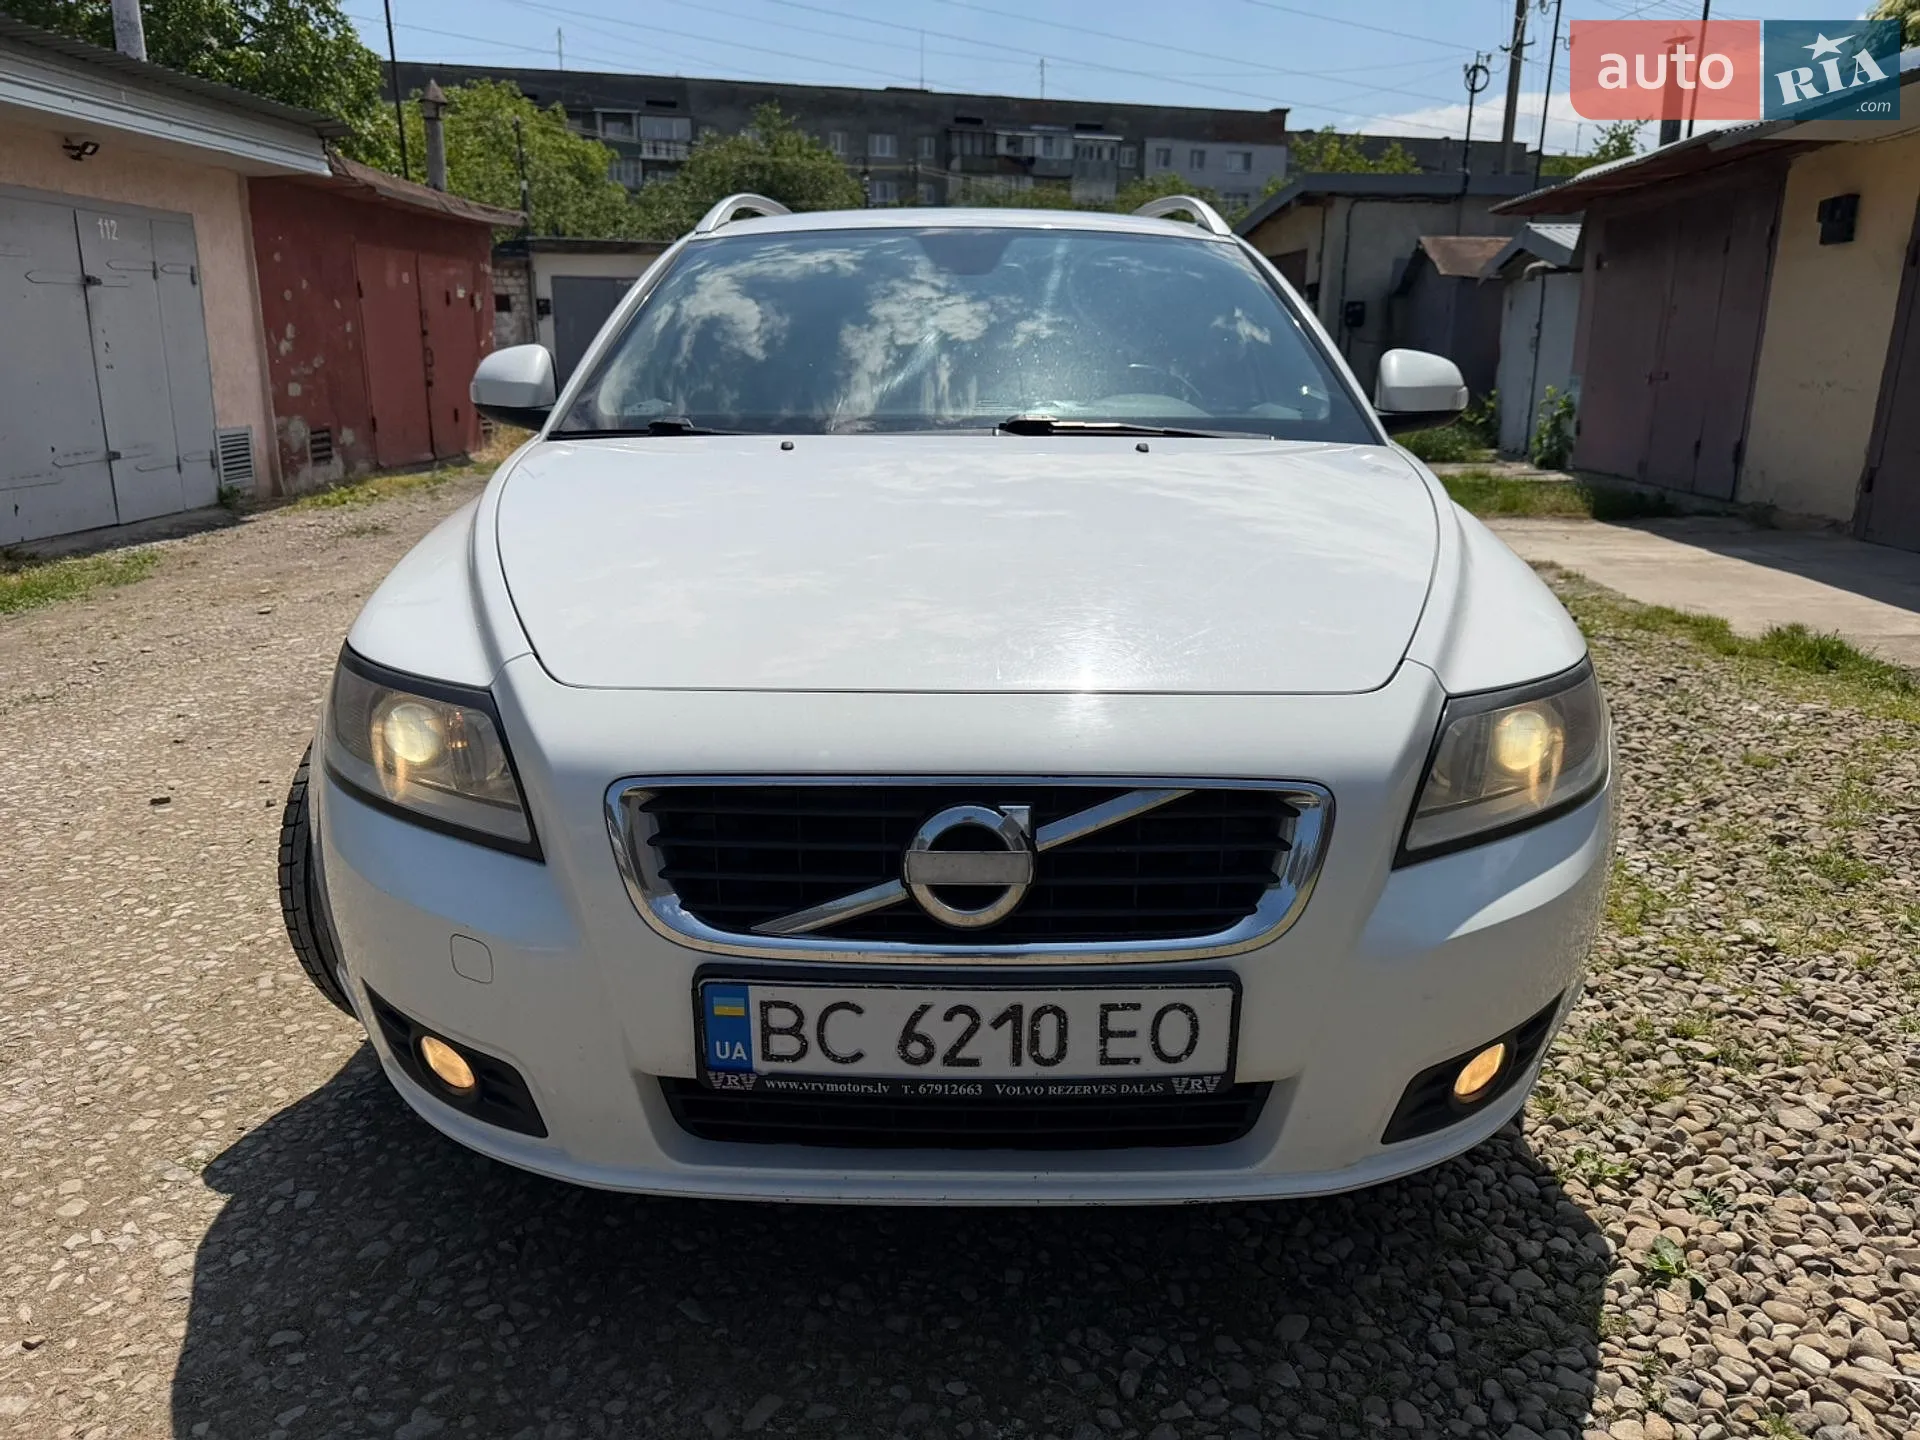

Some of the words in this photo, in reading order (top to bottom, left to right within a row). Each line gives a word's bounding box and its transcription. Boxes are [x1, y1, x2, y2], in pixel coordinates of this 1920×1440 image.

[97, 217, 118, 240] 112
[759, 1000, 865, 1064] BC
[897, 1002, 1069, 1068] 6210
[1098, 1002, 1199, 1064] EO
[715, 1041, 748, 1061] UA
[765, 1079, 890, 1094] www.vrvmotors.lv
[918, 1083, 983, 1096] 67912663
